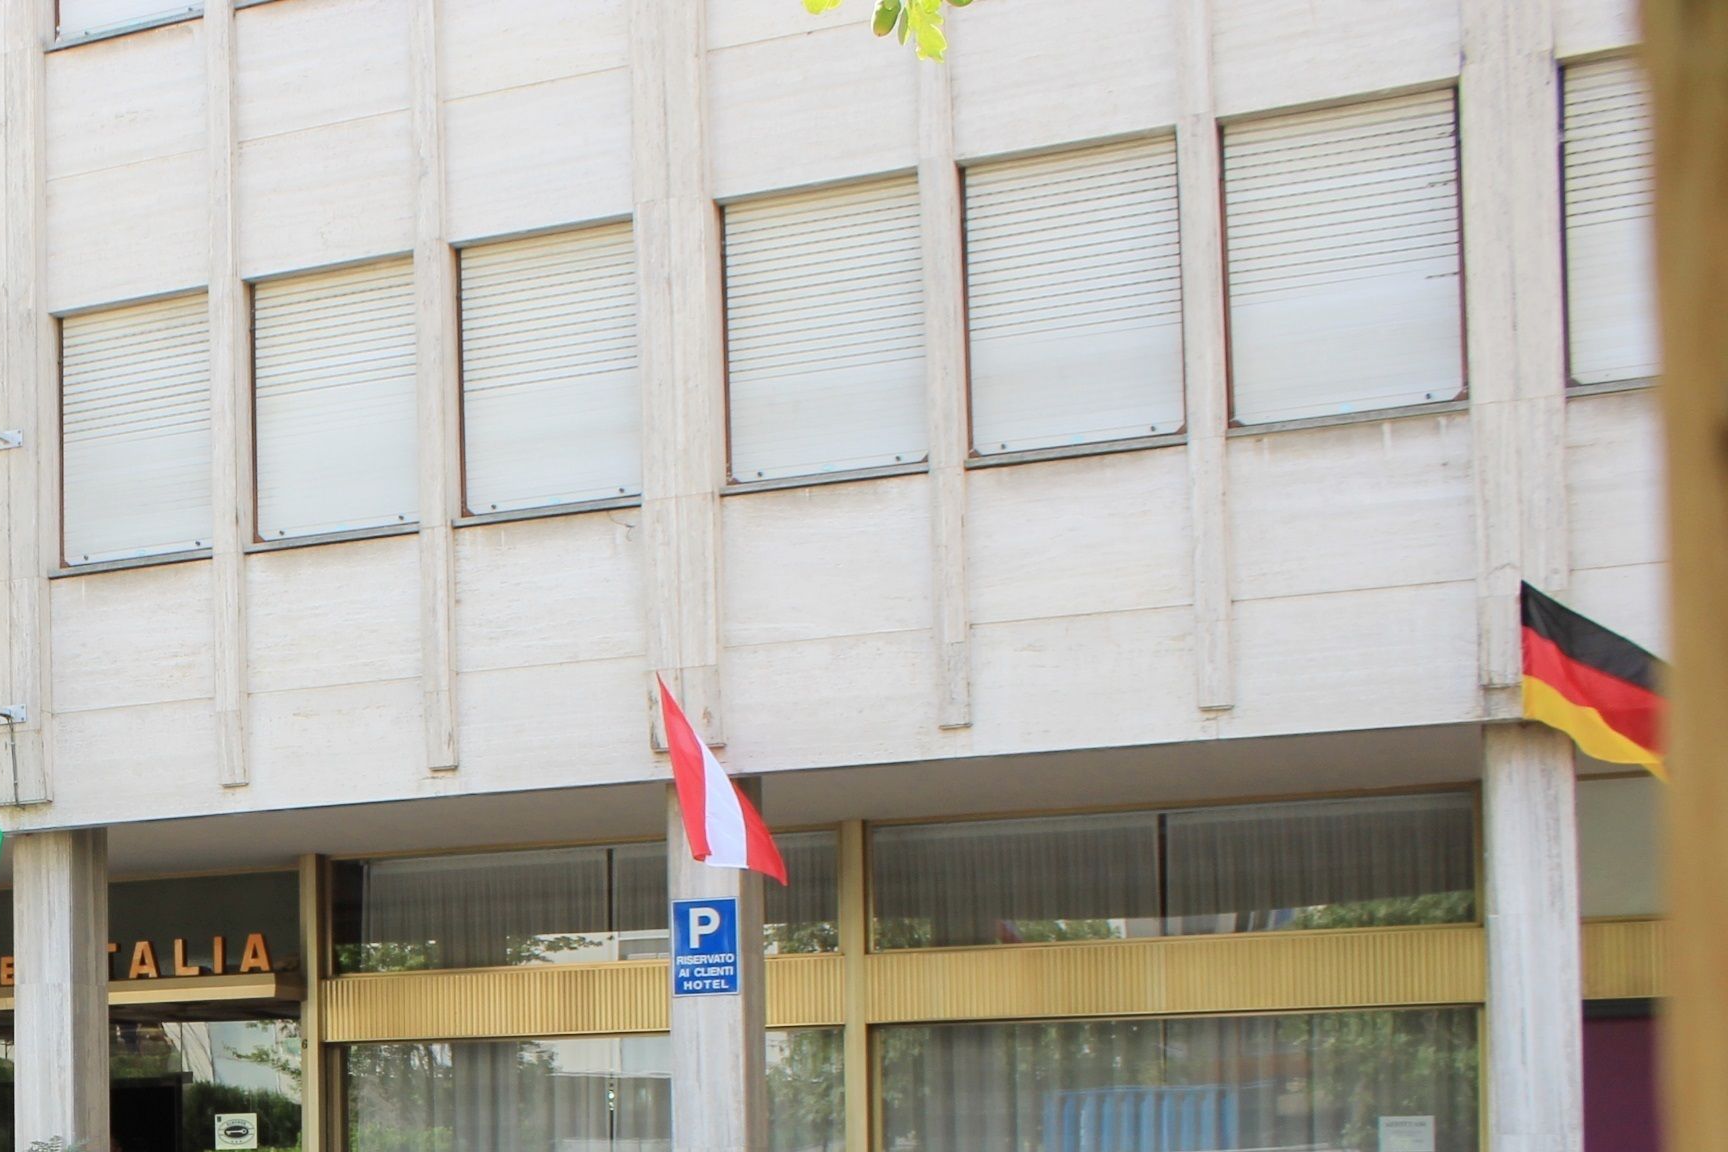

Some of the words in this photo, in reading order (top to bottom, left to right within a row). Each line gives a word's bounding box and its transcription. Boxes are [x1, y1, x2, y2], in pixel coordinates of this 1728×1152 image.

[688, 907, 721, 949] P
[108, 932, 271, 979] ALIA
[676, 953, 734, 966] RISERVATO
[678, 968, 690, 978] AI
[694, 966, 734, 977] CLIENTI
[683, 979, 729, 990] HOTEL
[301, 1039, 308, 1049] 6
